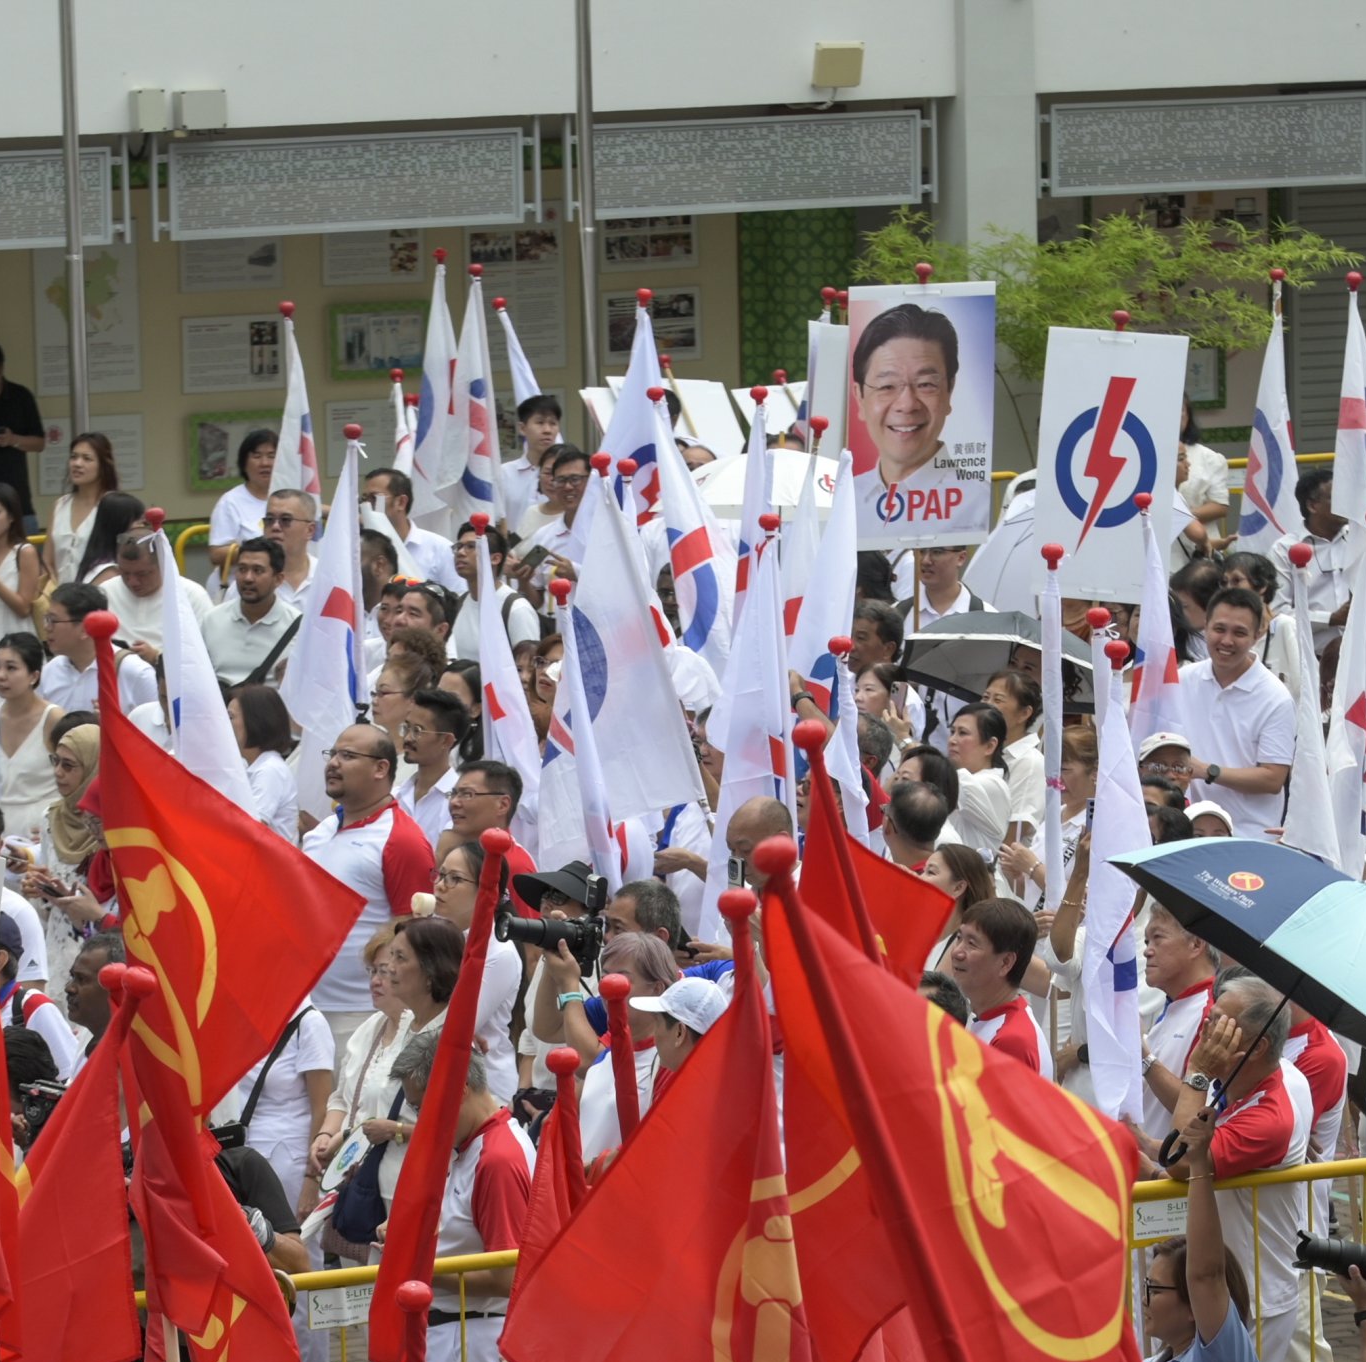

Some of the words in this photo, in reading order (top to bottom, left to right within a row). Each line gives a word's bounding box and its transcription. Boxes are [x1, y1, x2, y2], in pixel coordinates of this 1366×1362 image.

[934, 457, 986, 469] Lawrence
[955, 469, 986, 482] Wong
[907, 488, 962, 522] PAP
[1201, 870, 1213, 882] The
[1239, 892, 1256, 907] Party
[346, 1287, 374, 1299] S-LITE
